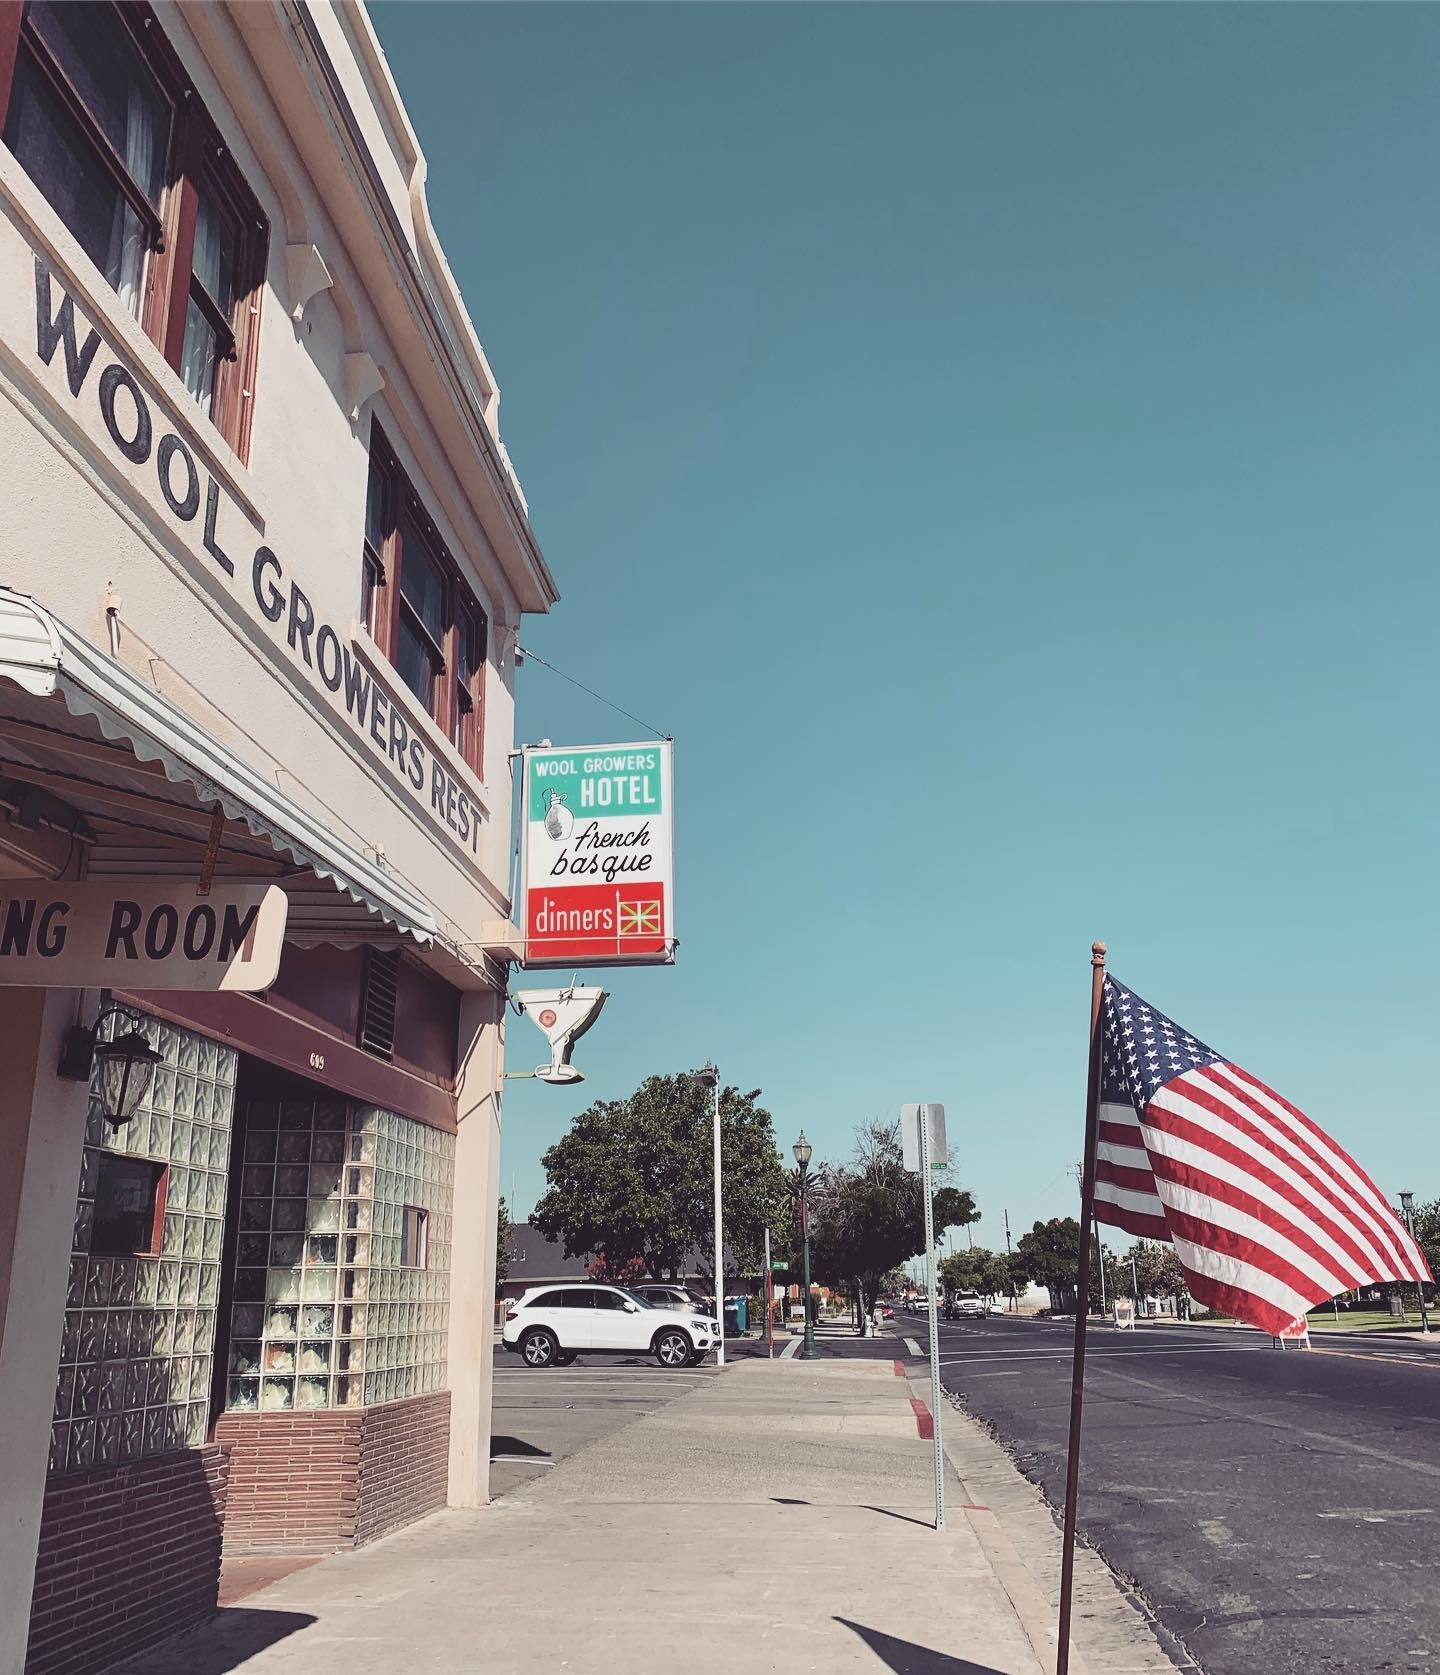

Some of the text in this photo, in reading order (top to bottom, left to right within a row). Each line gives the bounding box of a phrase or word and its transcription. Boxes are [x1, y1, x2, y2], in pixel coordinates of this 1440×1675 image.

[35, 256, 482, 853] WOOL GROWERS REST
[536, 754, 656, 777] WOOL GROWERS
[581, 775, 656, 808] HOTEL
[575, 821, 651, 851] french
[550, 848, 653, 883] basque
[104, 900, 259, 963] ROOM
[536, 897, 613, 932] dinners
